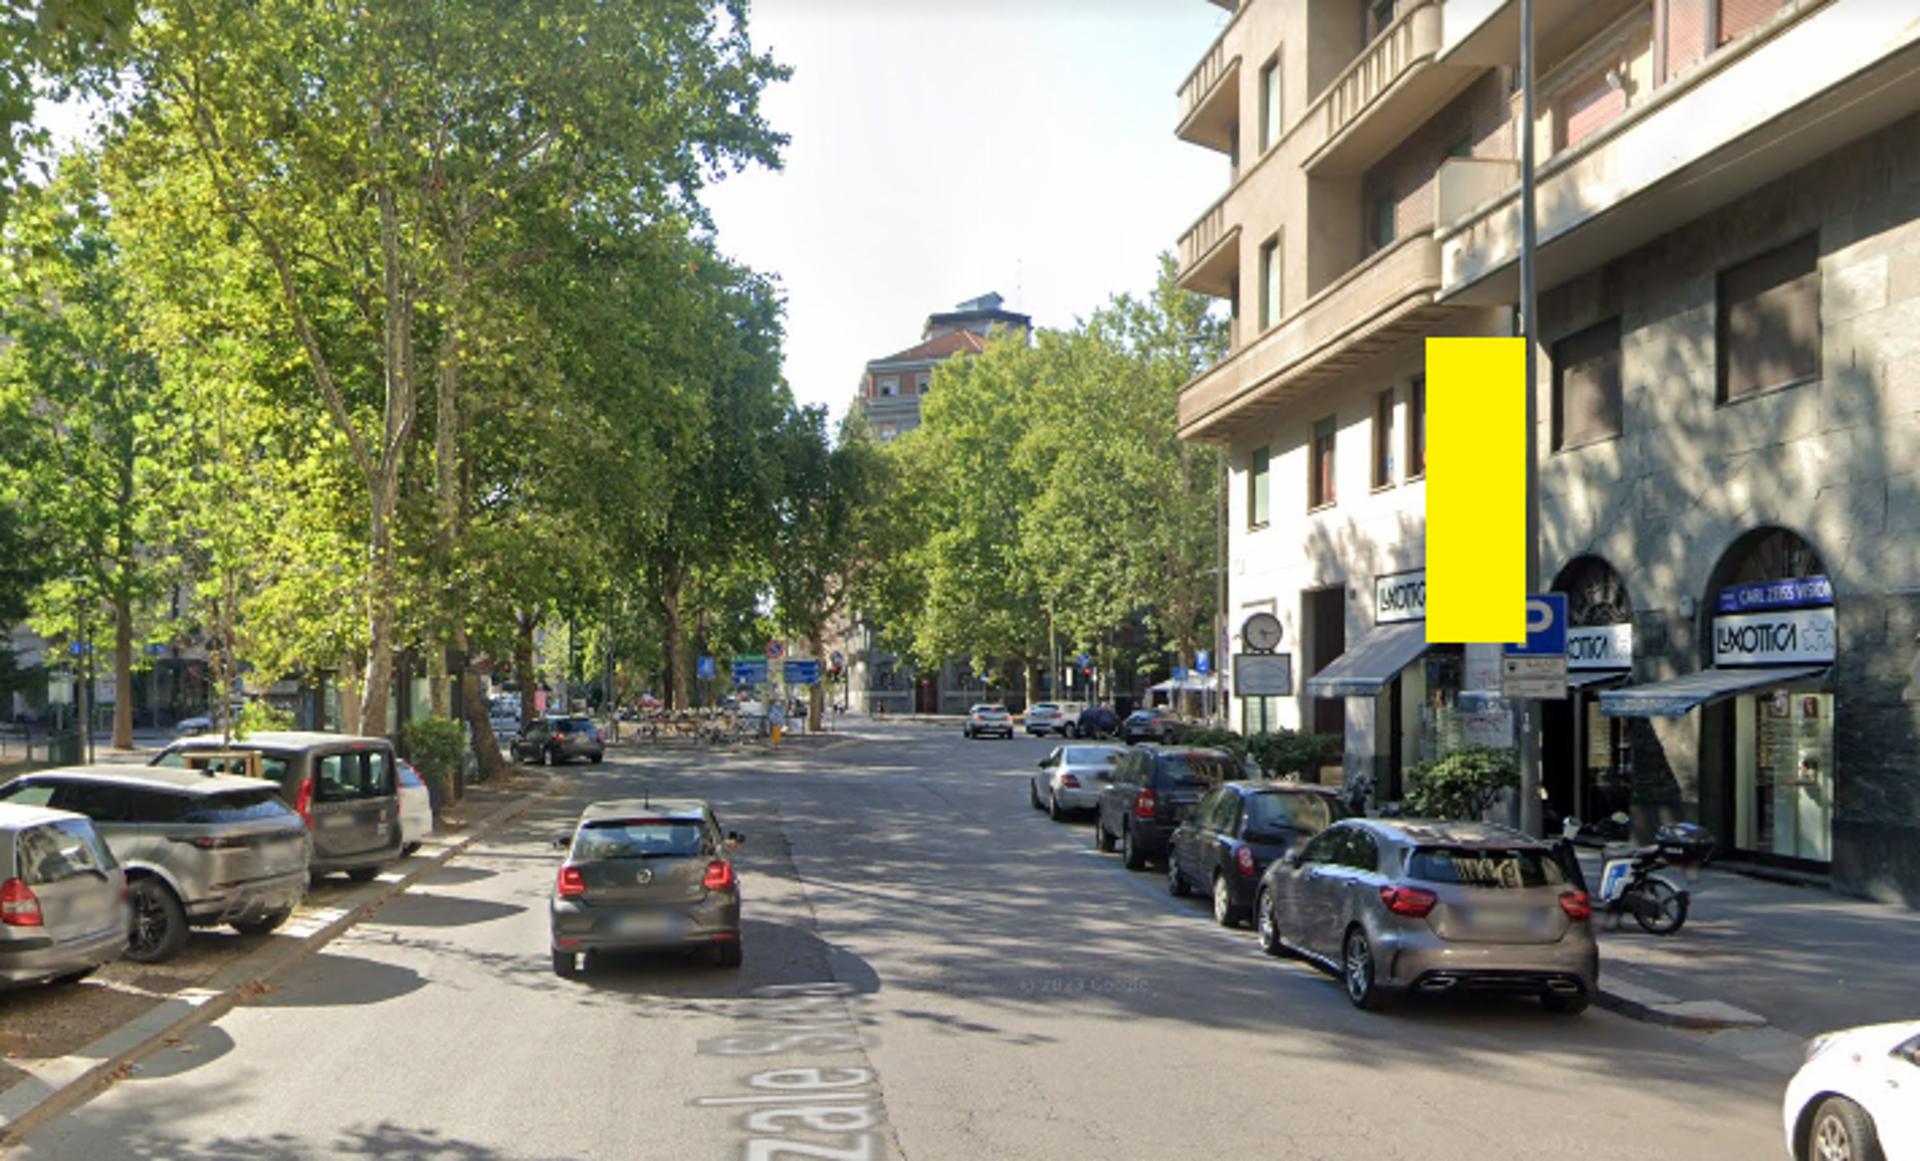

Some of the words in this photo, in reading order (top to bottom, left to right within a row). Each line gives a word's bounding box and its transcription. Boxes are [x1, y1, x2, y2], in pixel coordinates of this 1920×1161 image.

[1739, 587, 1764, 605] CARL
[1766, 584, 1795, 602] ZEISS
[1717, 623, 1797, 654] LUXOTTICA
